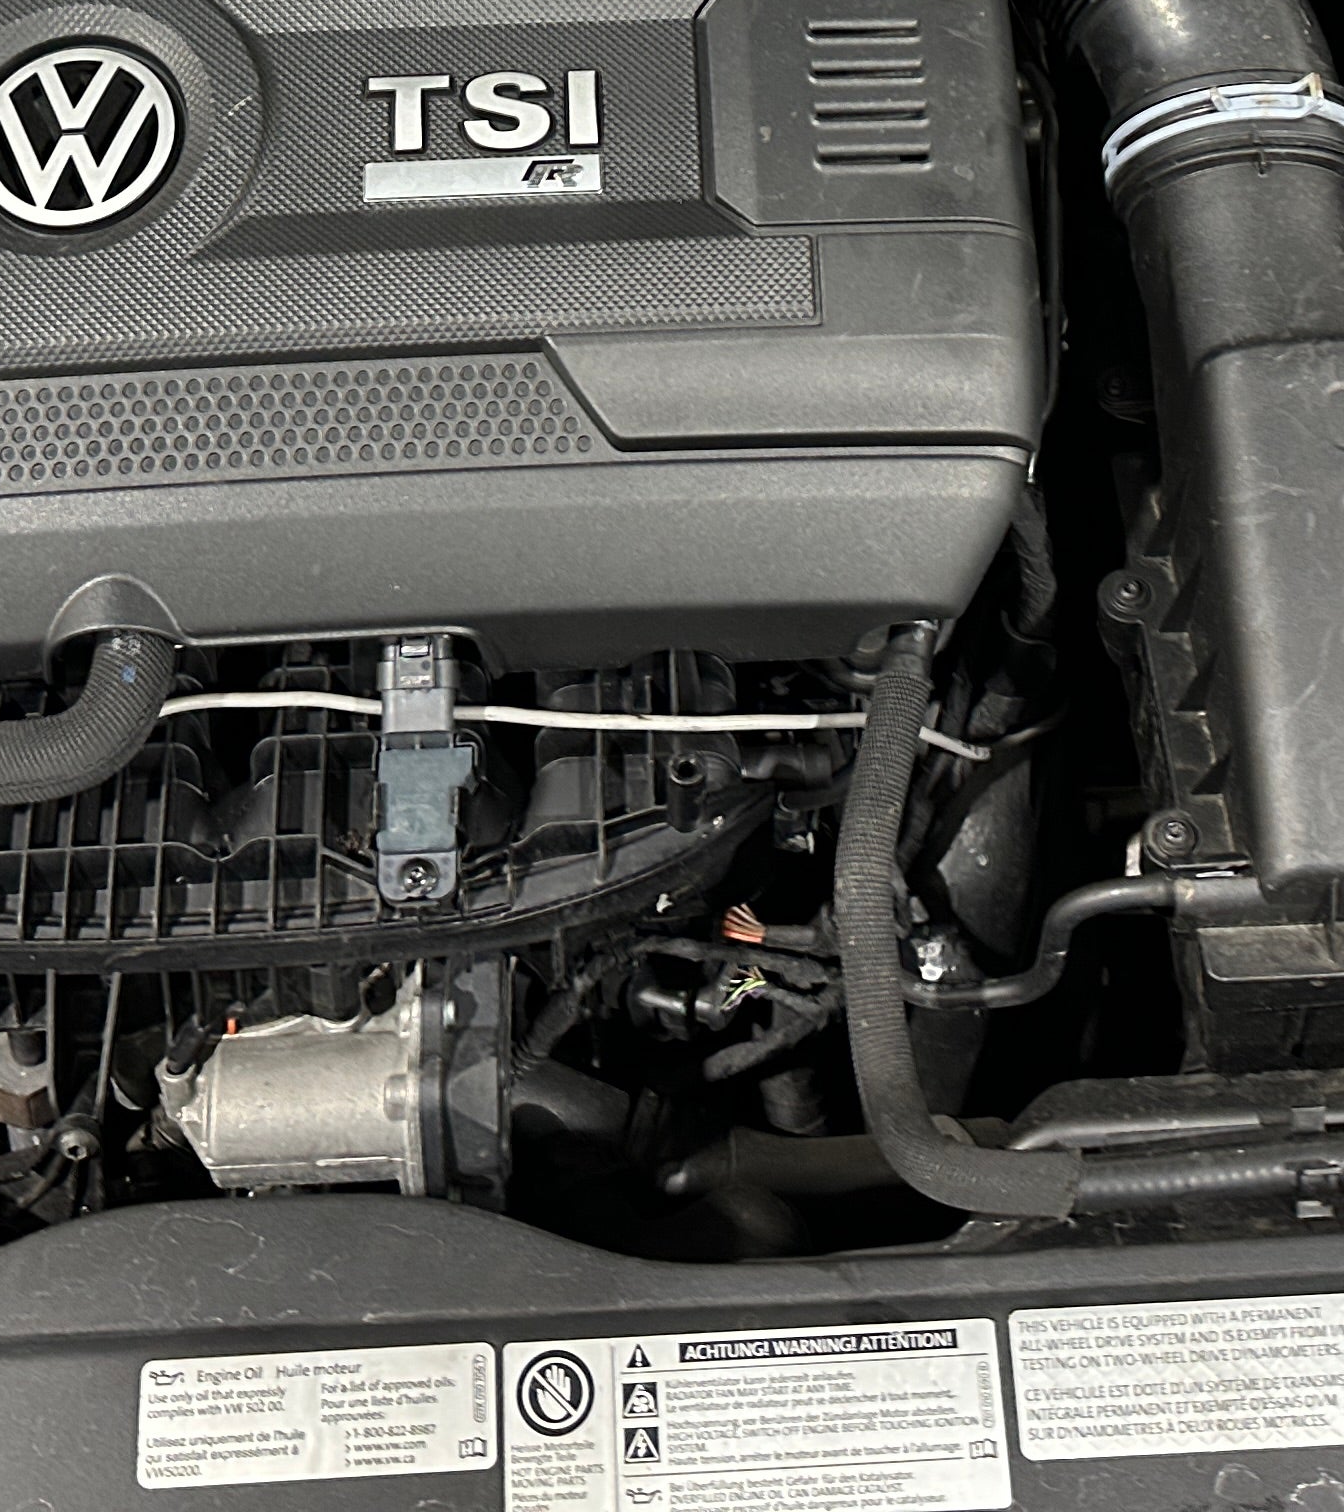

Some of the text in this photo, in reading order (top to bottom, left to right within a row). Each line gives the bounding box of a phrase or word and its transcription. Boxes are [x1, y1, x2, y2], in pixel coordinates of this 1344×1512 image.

[364, 69, 601, 151] TSI
[1017, 1306, 1322, 1333] THIS VEHICLE IS EQUIPPED WITH A PERMANENT
[683, 1331, 952, 1360] ACHTUNG! WARNING! ATTENTION!
[1018, 1336, 1092, 1352] ALL-WHEEL
[1094, 1334, 1134, 1348] DRIVE
[1136, 1331, 1186, 1346] SYSTEM
[1188, 1329, 1220, 1343] AND
[1221, 1329, 1234, 1341] IS
[1235, 1326, 1288, 1341] EXEMPT
[1288, 1324, 1328, 1338] FROM
[1020, 1355, 1077, 1371] TESTING
[1078, 1354, 1102, 1368] ON
[1102, 1350, 1187, 1367] TWO-WHEEL
[1188, 1347, 1230, 1362] DRIVE
[196, 1361, 361, 1386] Engine Oil Huile moteur
[321, 1382, 337, 1394] For
[340, 1383, 348, 1393] a
[348, 1380, 365, 1392] list
[368, 1379, 380, 1391] of
[382, 1377, 431, 1393] approved
[147, 1386, 286, 1405] Use only oil that expressly
[1023, 1388, 1042, 1402] CE
[1107, 1384, 1131, 1398] EST
[1262, 1376, 1283, 1390] DE
[1095, 1401, 1174, 1418] PERMANENT
[1175, 1400, 1190, 1414] ET
[1027, 1427, 1054, 1441] SUR
[1177, 1418, 1214, 1433] DEUX
[1215, 1416, 1261, 1431] ROUES
[511, 1463, 605, 1477] HOT ENGINE PARTS
[511, 1475, 586, 1489] MOVING PARTS
